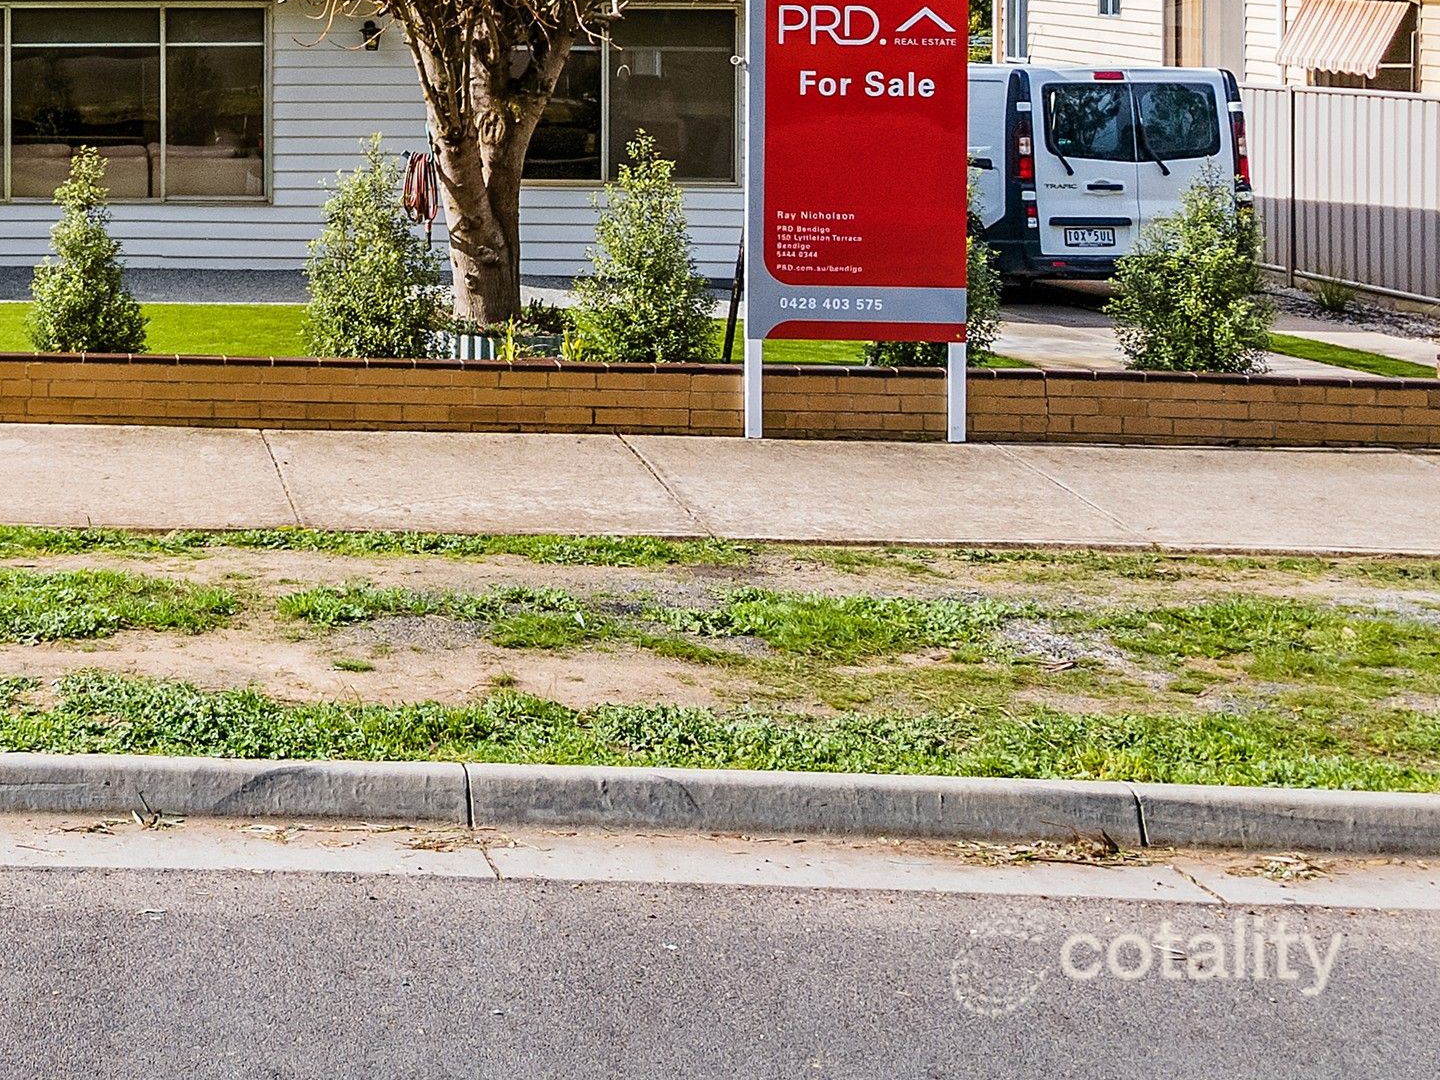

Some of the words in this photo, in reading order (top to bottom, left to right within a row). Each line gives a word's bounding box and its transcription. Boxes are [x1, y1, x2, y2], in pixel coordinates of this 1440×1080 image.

[894, 38, 919, 46] REAL
[921, 38, 957, 46] ESTATE
[799, 70, 852, 96] For
[864, 70, 936, 98] Sale
[776, 211, 796, 220] Ray
[800, 211, 855, 220] Nicholson
[796, 225, 831, 234] Bendigo
[832, 234, 863, 242] Terrace
[776, 242, 811, 250] Bendigo
[776, 264, 863, 273] PRD.com.au/bendigo
[779, 297, 817, 310] 0428
[822, 297, 850, 310] 403
[856, 298, 883, 311] 575
